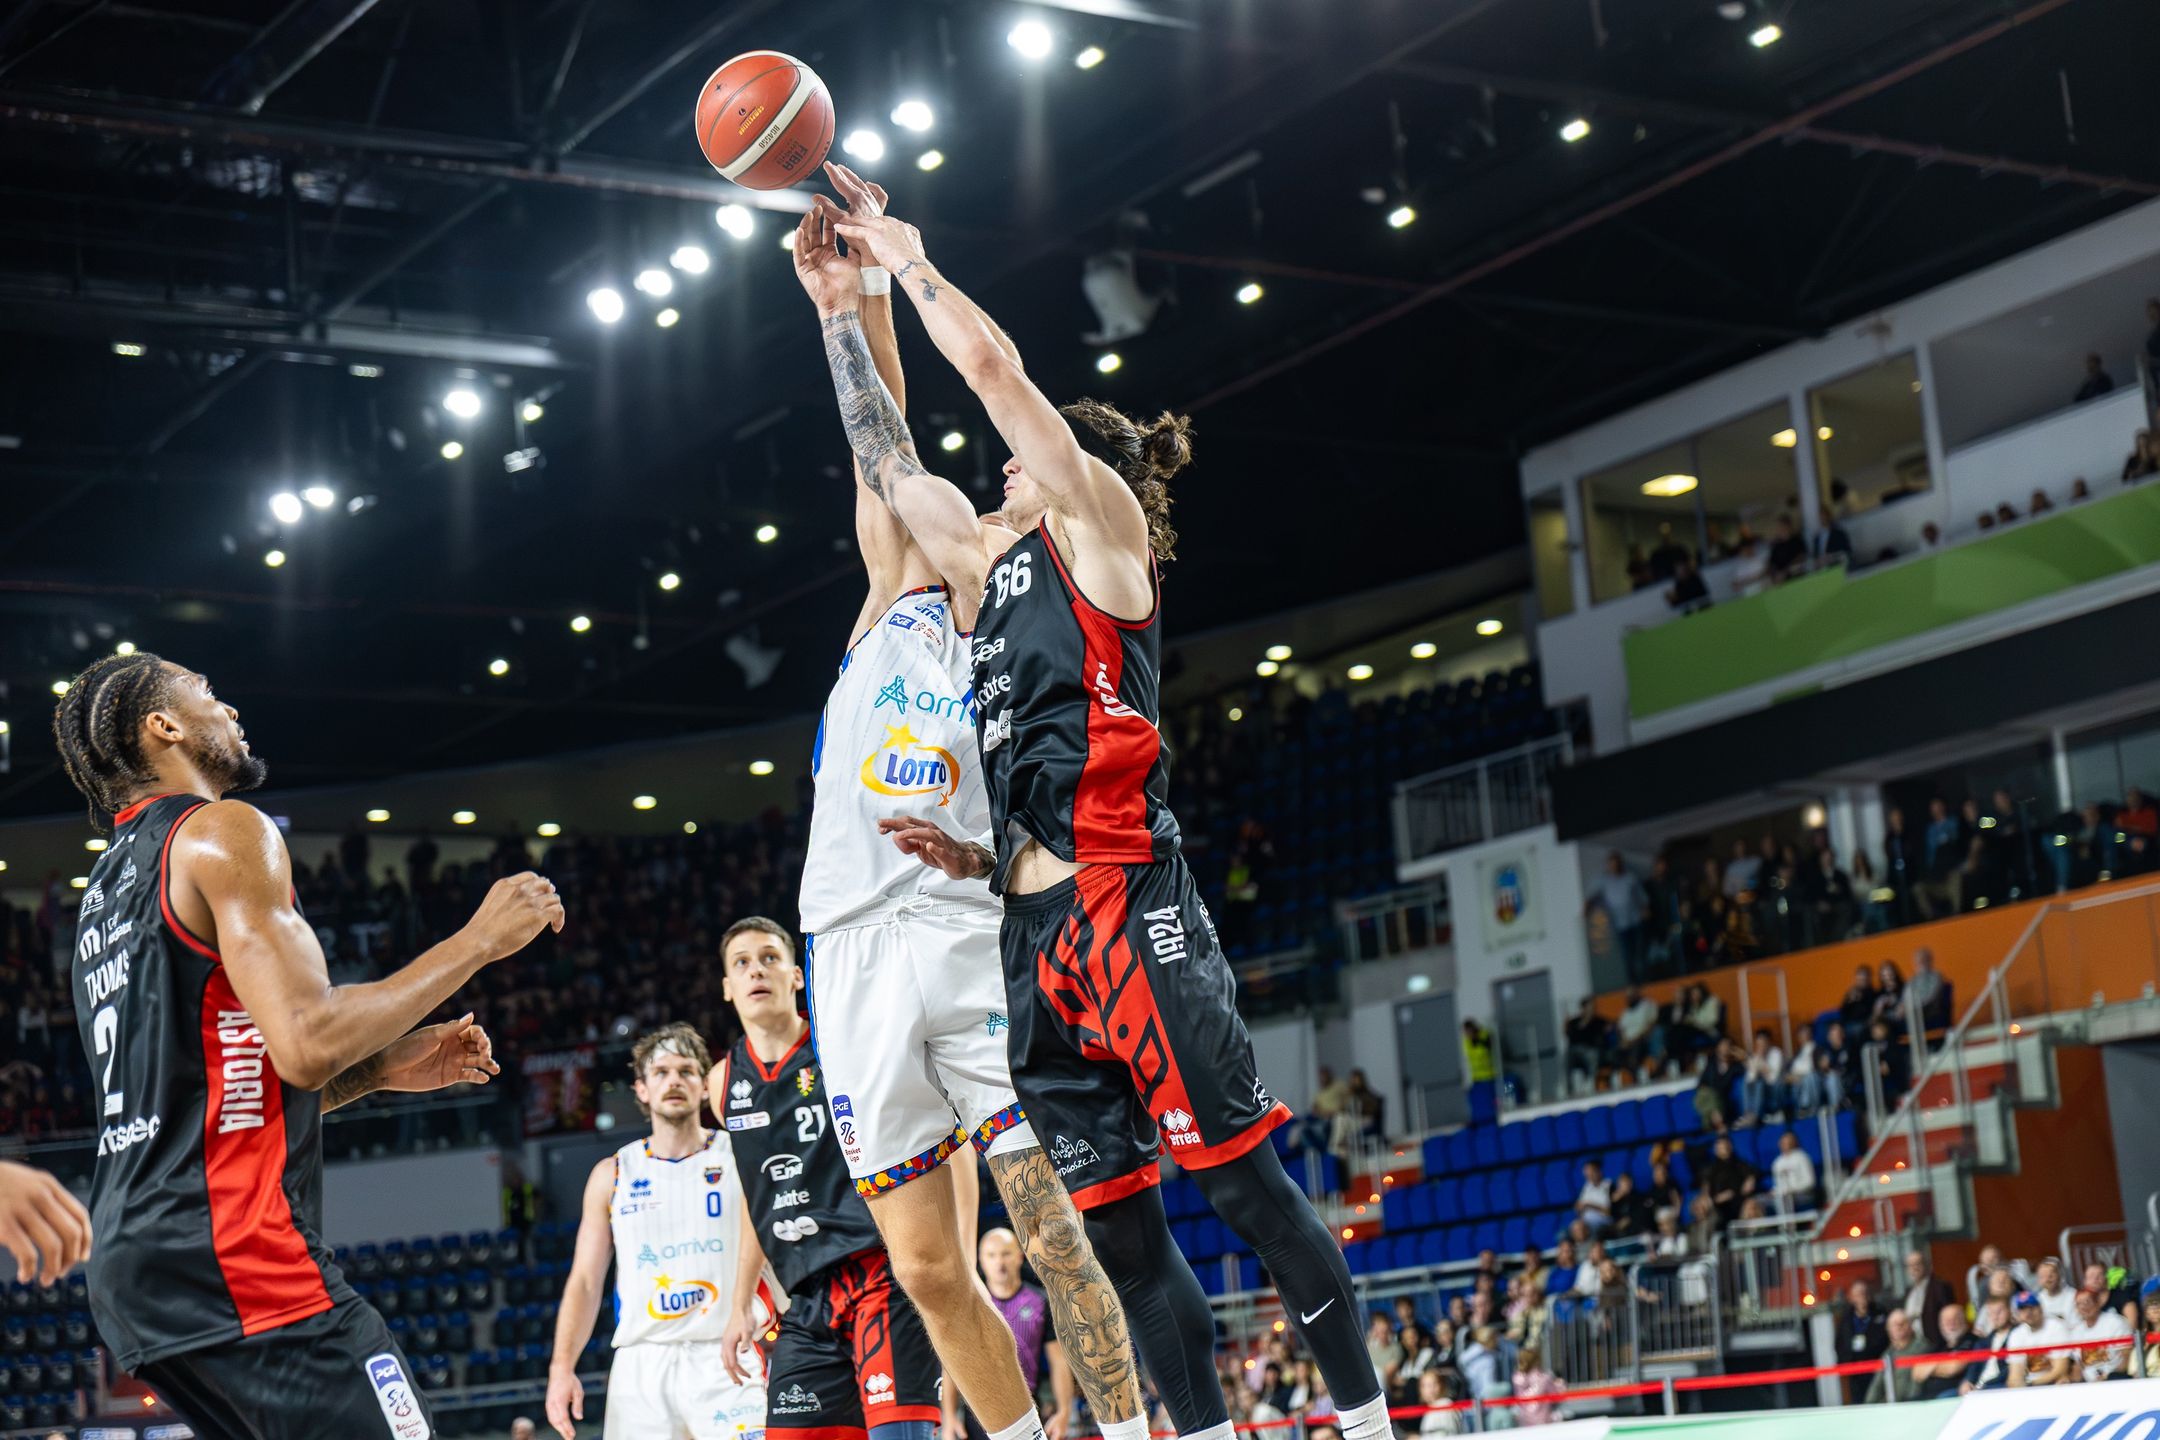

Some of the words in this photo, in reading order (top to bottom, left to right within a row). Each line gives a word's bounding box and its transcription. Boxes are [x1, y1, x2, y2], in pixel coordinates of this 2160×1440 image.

[783, 144, 808, 171] FIBA
[995, 551, 1032, 609] 66
[885, 753, 946, 786] LOTTO
[1143, 905, 1187, 964] 1924
[85, 949, 130, 1009] THOMAS
[93, 1006, 123, 1116] 2
[217, 1010, 268, 1134] ASTORIA
[834, 1102, 849, 1113] PGE
[794, 1104, 826, 1143] 21
[1169, 1131, 1201, 1146] errea
[1055, 1154, 1096, 1177] YDGOSZCZ
[707, 1191, 721, 1218] 0
[661, 1238, 724, 1260] arriva
[660, 1289, 705, 1312] LOTTO
